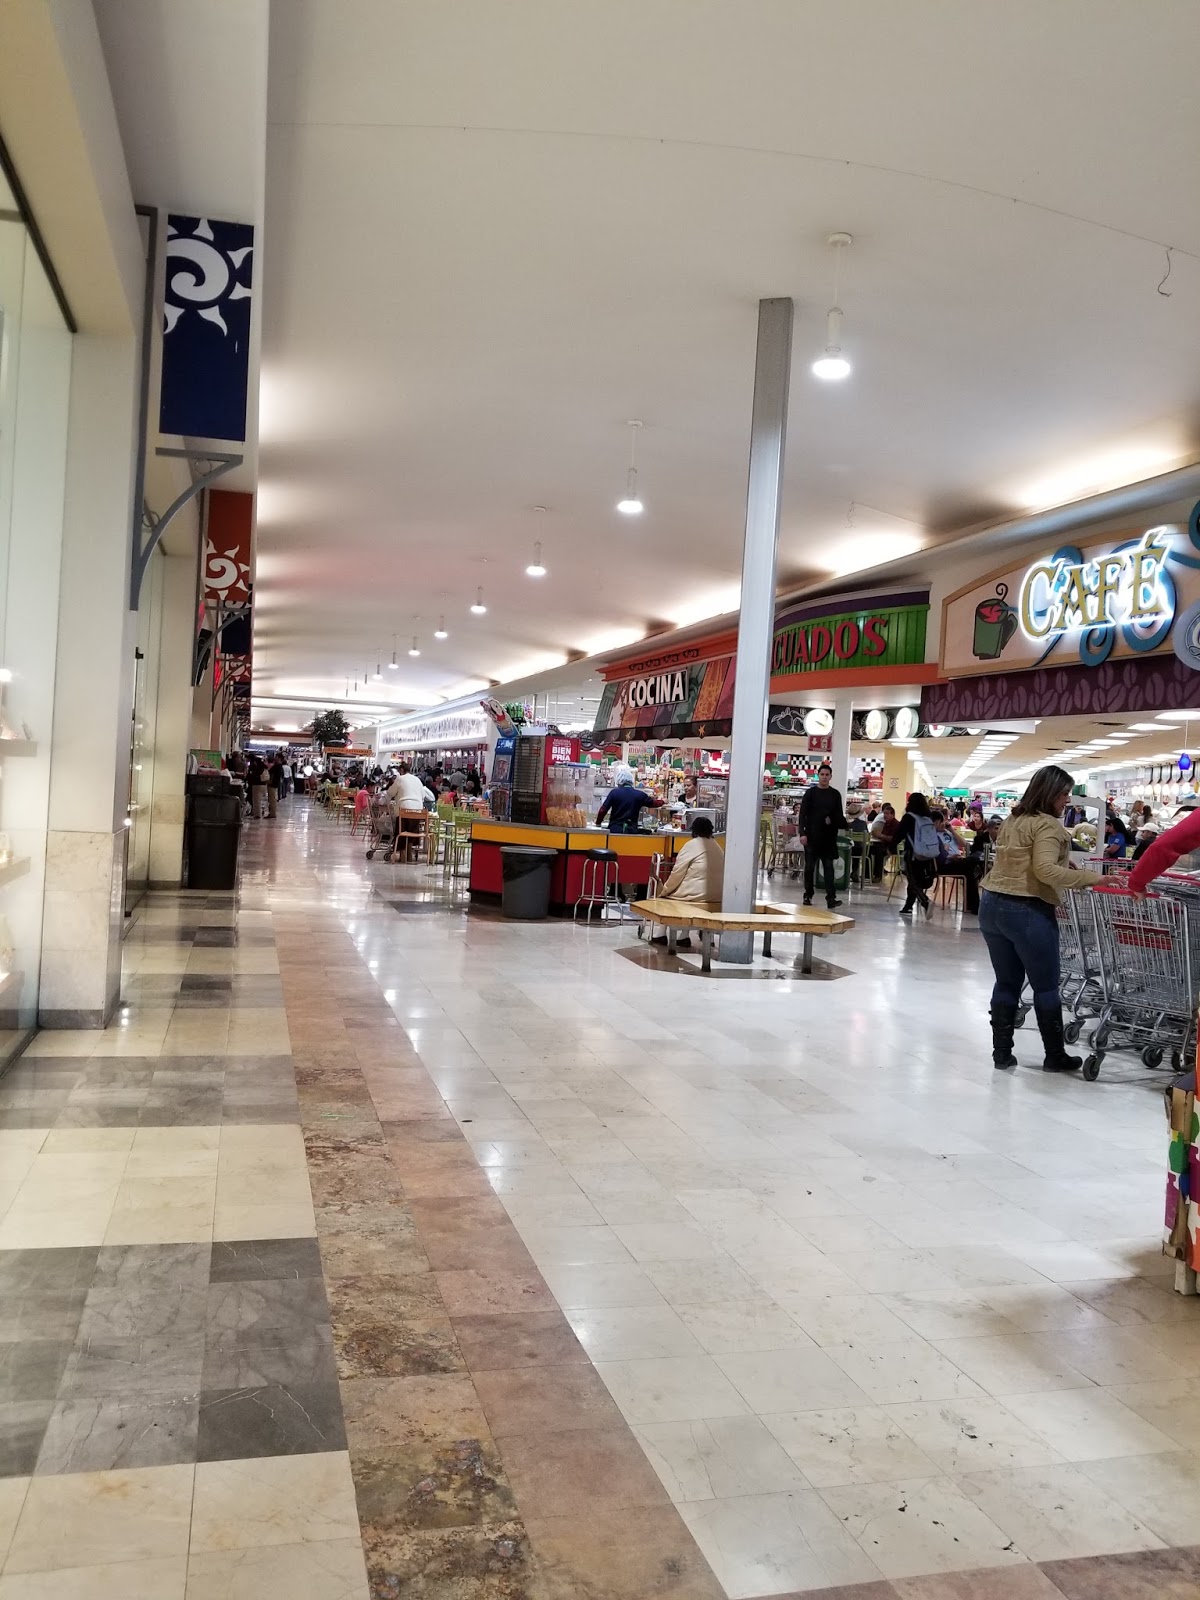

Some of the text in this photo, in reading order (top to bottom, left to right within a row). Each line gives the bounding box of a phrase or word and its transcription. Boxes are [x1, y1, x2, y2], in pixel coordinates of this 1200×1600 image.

[1020, 528, 1170, 640] CAFÉ
[771, 617, 888, 671] CUADOS
[629, 672, 684, 708] COCINA
[552, 746, 572, 755] BIEN
